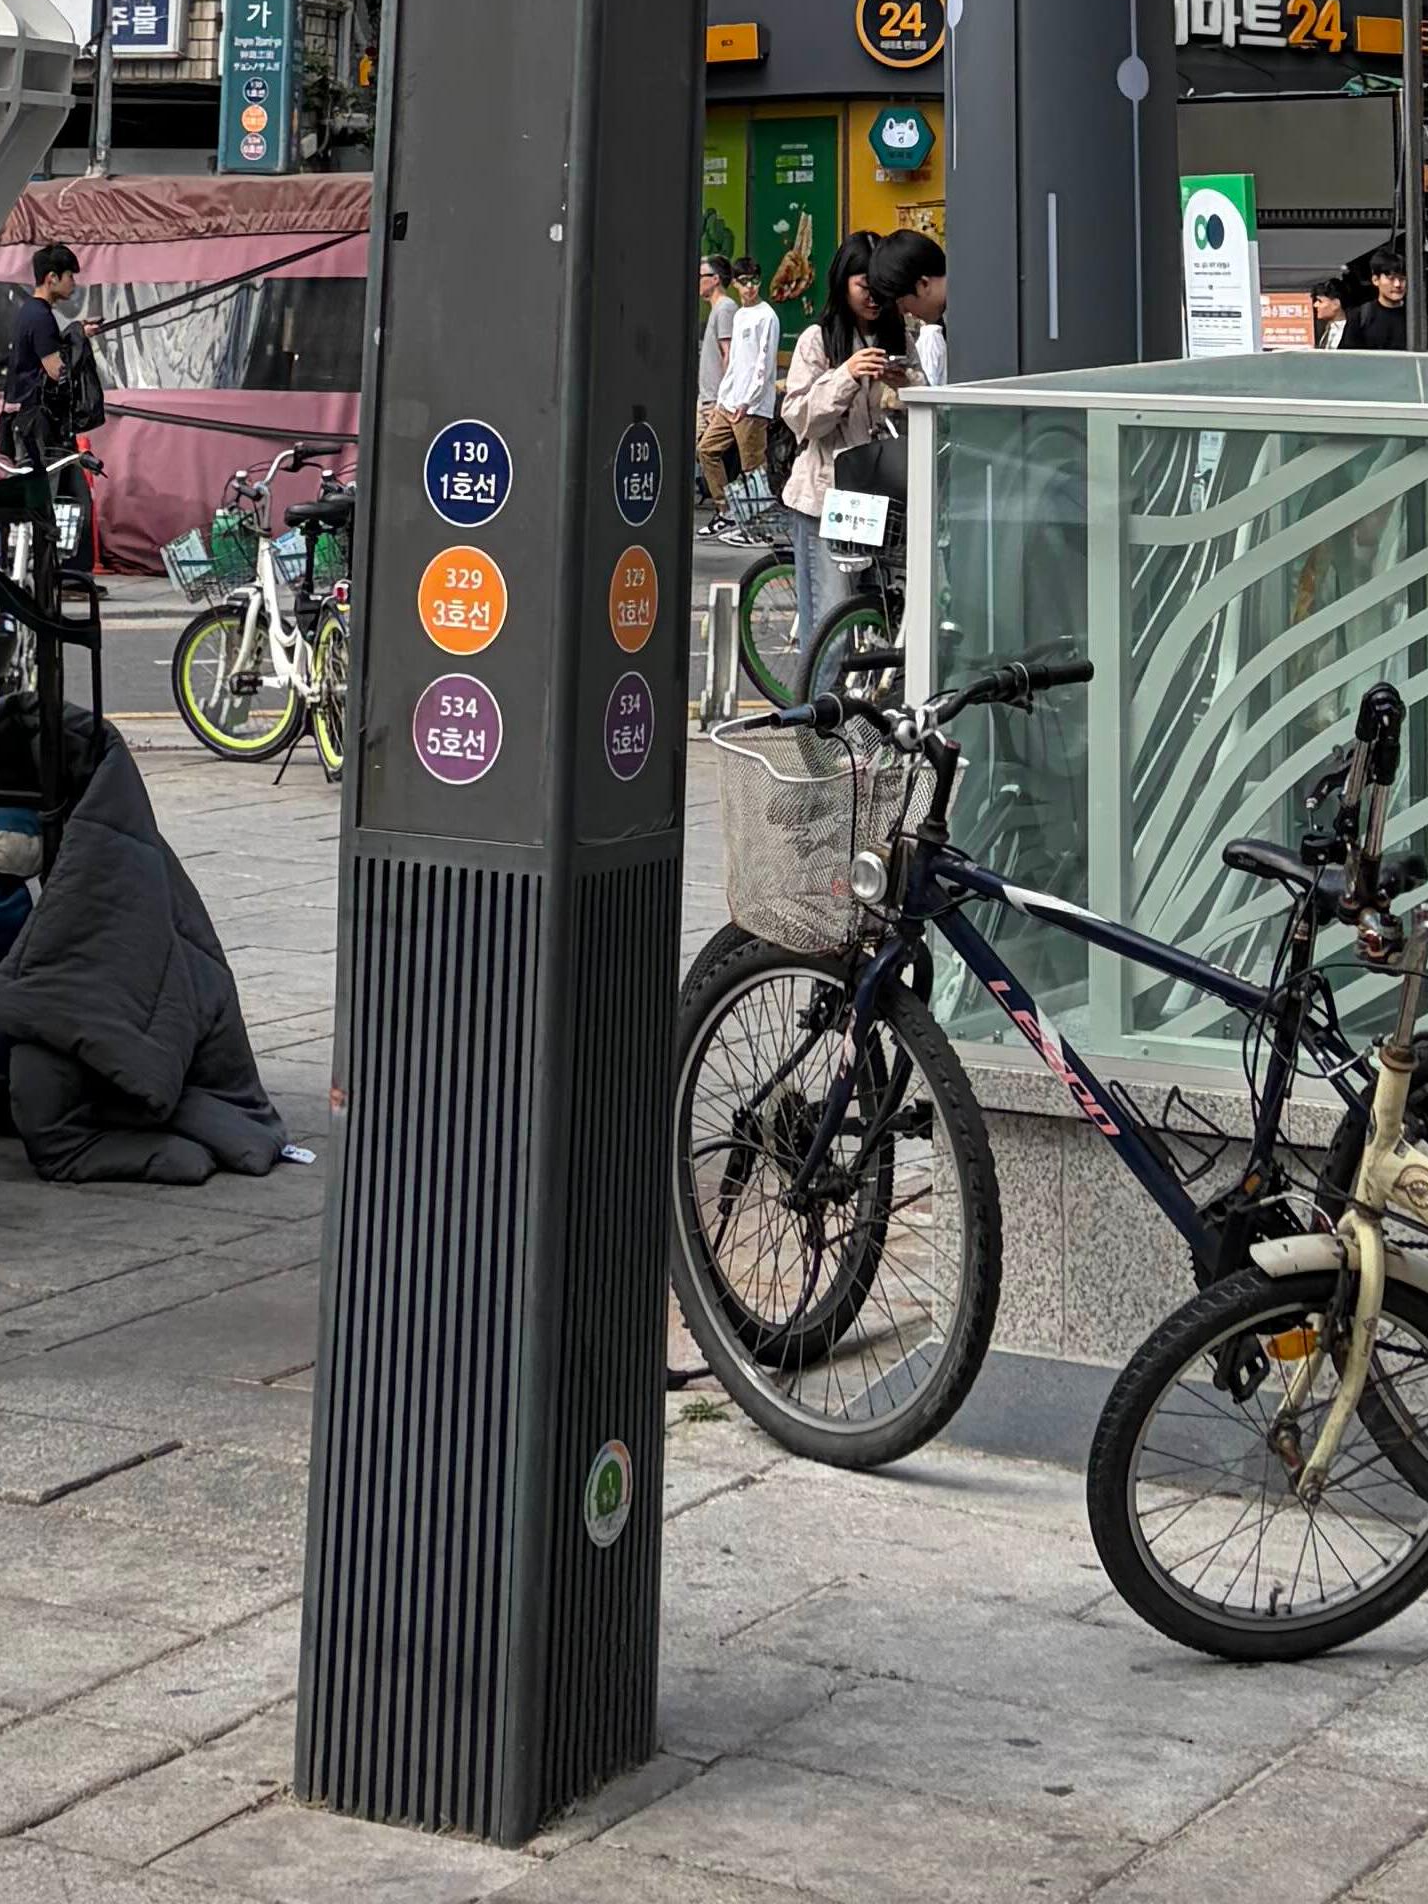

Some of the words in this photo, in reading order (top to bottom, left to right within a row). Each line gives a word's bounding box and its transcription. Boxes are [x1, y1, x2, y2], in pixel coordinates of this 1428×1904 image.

[879, 2, 926, 37] 24
[452, 441, 489, 464] 130
[629, 441, 649, 462] 130
[439, 472, 496, 503] 1호선
[623, 472, 654, 501] 1호선
[444, 568, 483, 590] 329
[624, 567, 646, 588] 329
[432, 599, 491, 631] 3호선
[618, 600, 650, 628] 3호선
[439, 695, 478, 719] 534
[620, 694, 641, 715] 534
[427, 727, 486, 760] 5호선
[612, 726, 645, 755] 5호선
